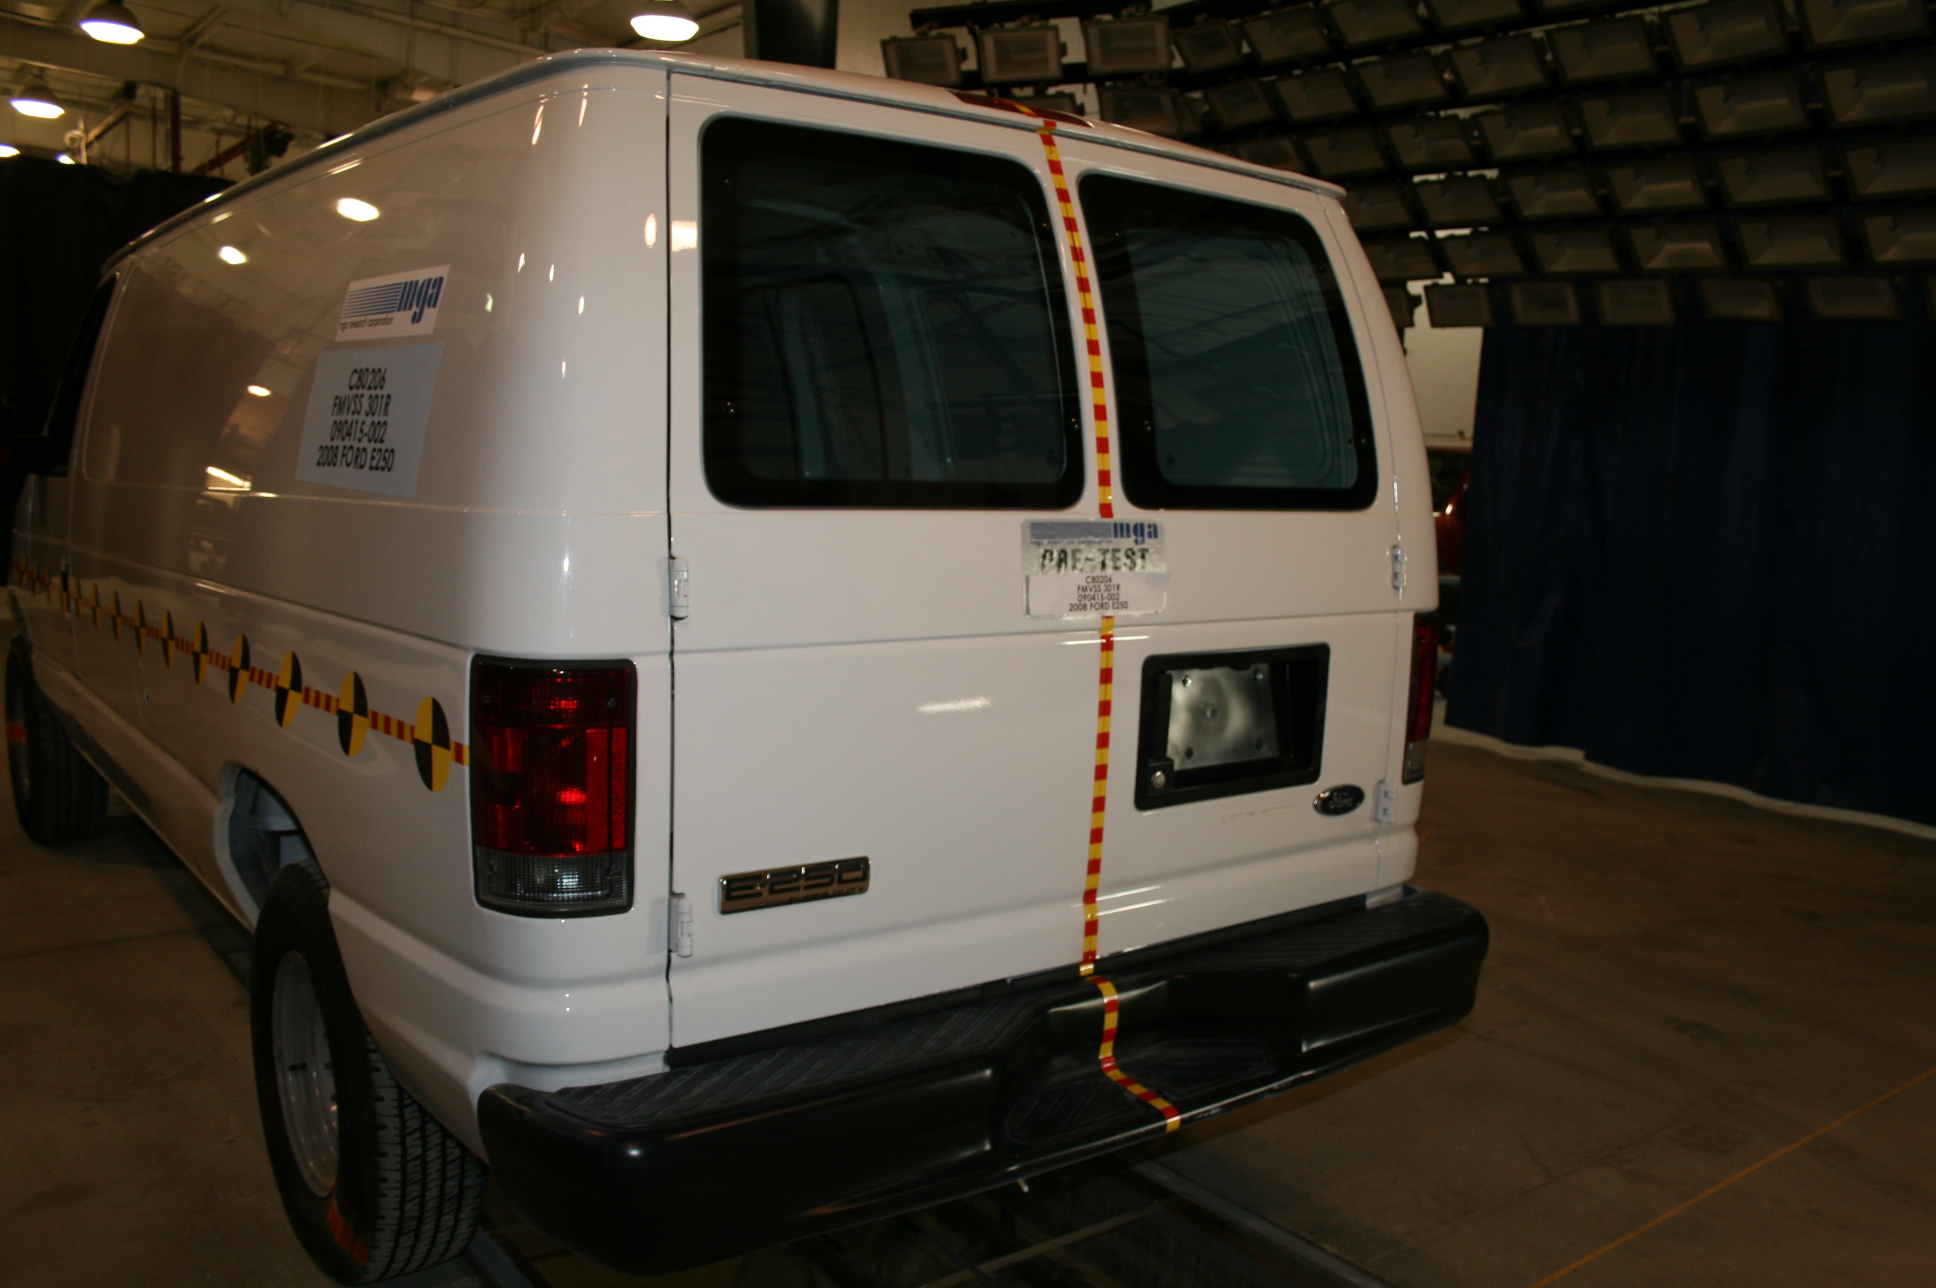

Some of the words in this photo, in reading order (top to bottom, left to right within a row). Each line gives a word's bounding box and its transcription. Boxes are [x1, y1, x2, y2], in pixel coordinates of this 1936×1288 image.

[396, 276, 444, 325] mga
[331, 393, 364, 417] FMVSS
[365, 393, 391, 417] 301R
[330, 419, 388, 444] 090415-002
[316, 444, 339, 468] 2008
[340, 444, 367, 470] FORD
[369, 447, 395, 472] E250
[1113, 522, 1159, 545] mga
[1077, 584, 1102, 593] FMVSS
[1103, 583, 1121, 592] 301R
[1077, 592, 1120, 602] 090415-002
[1069, 602, 1087, 612] 2008
[1089, 601, 1110, 611] FORD
[1112, 600, 1129, 610] E250
